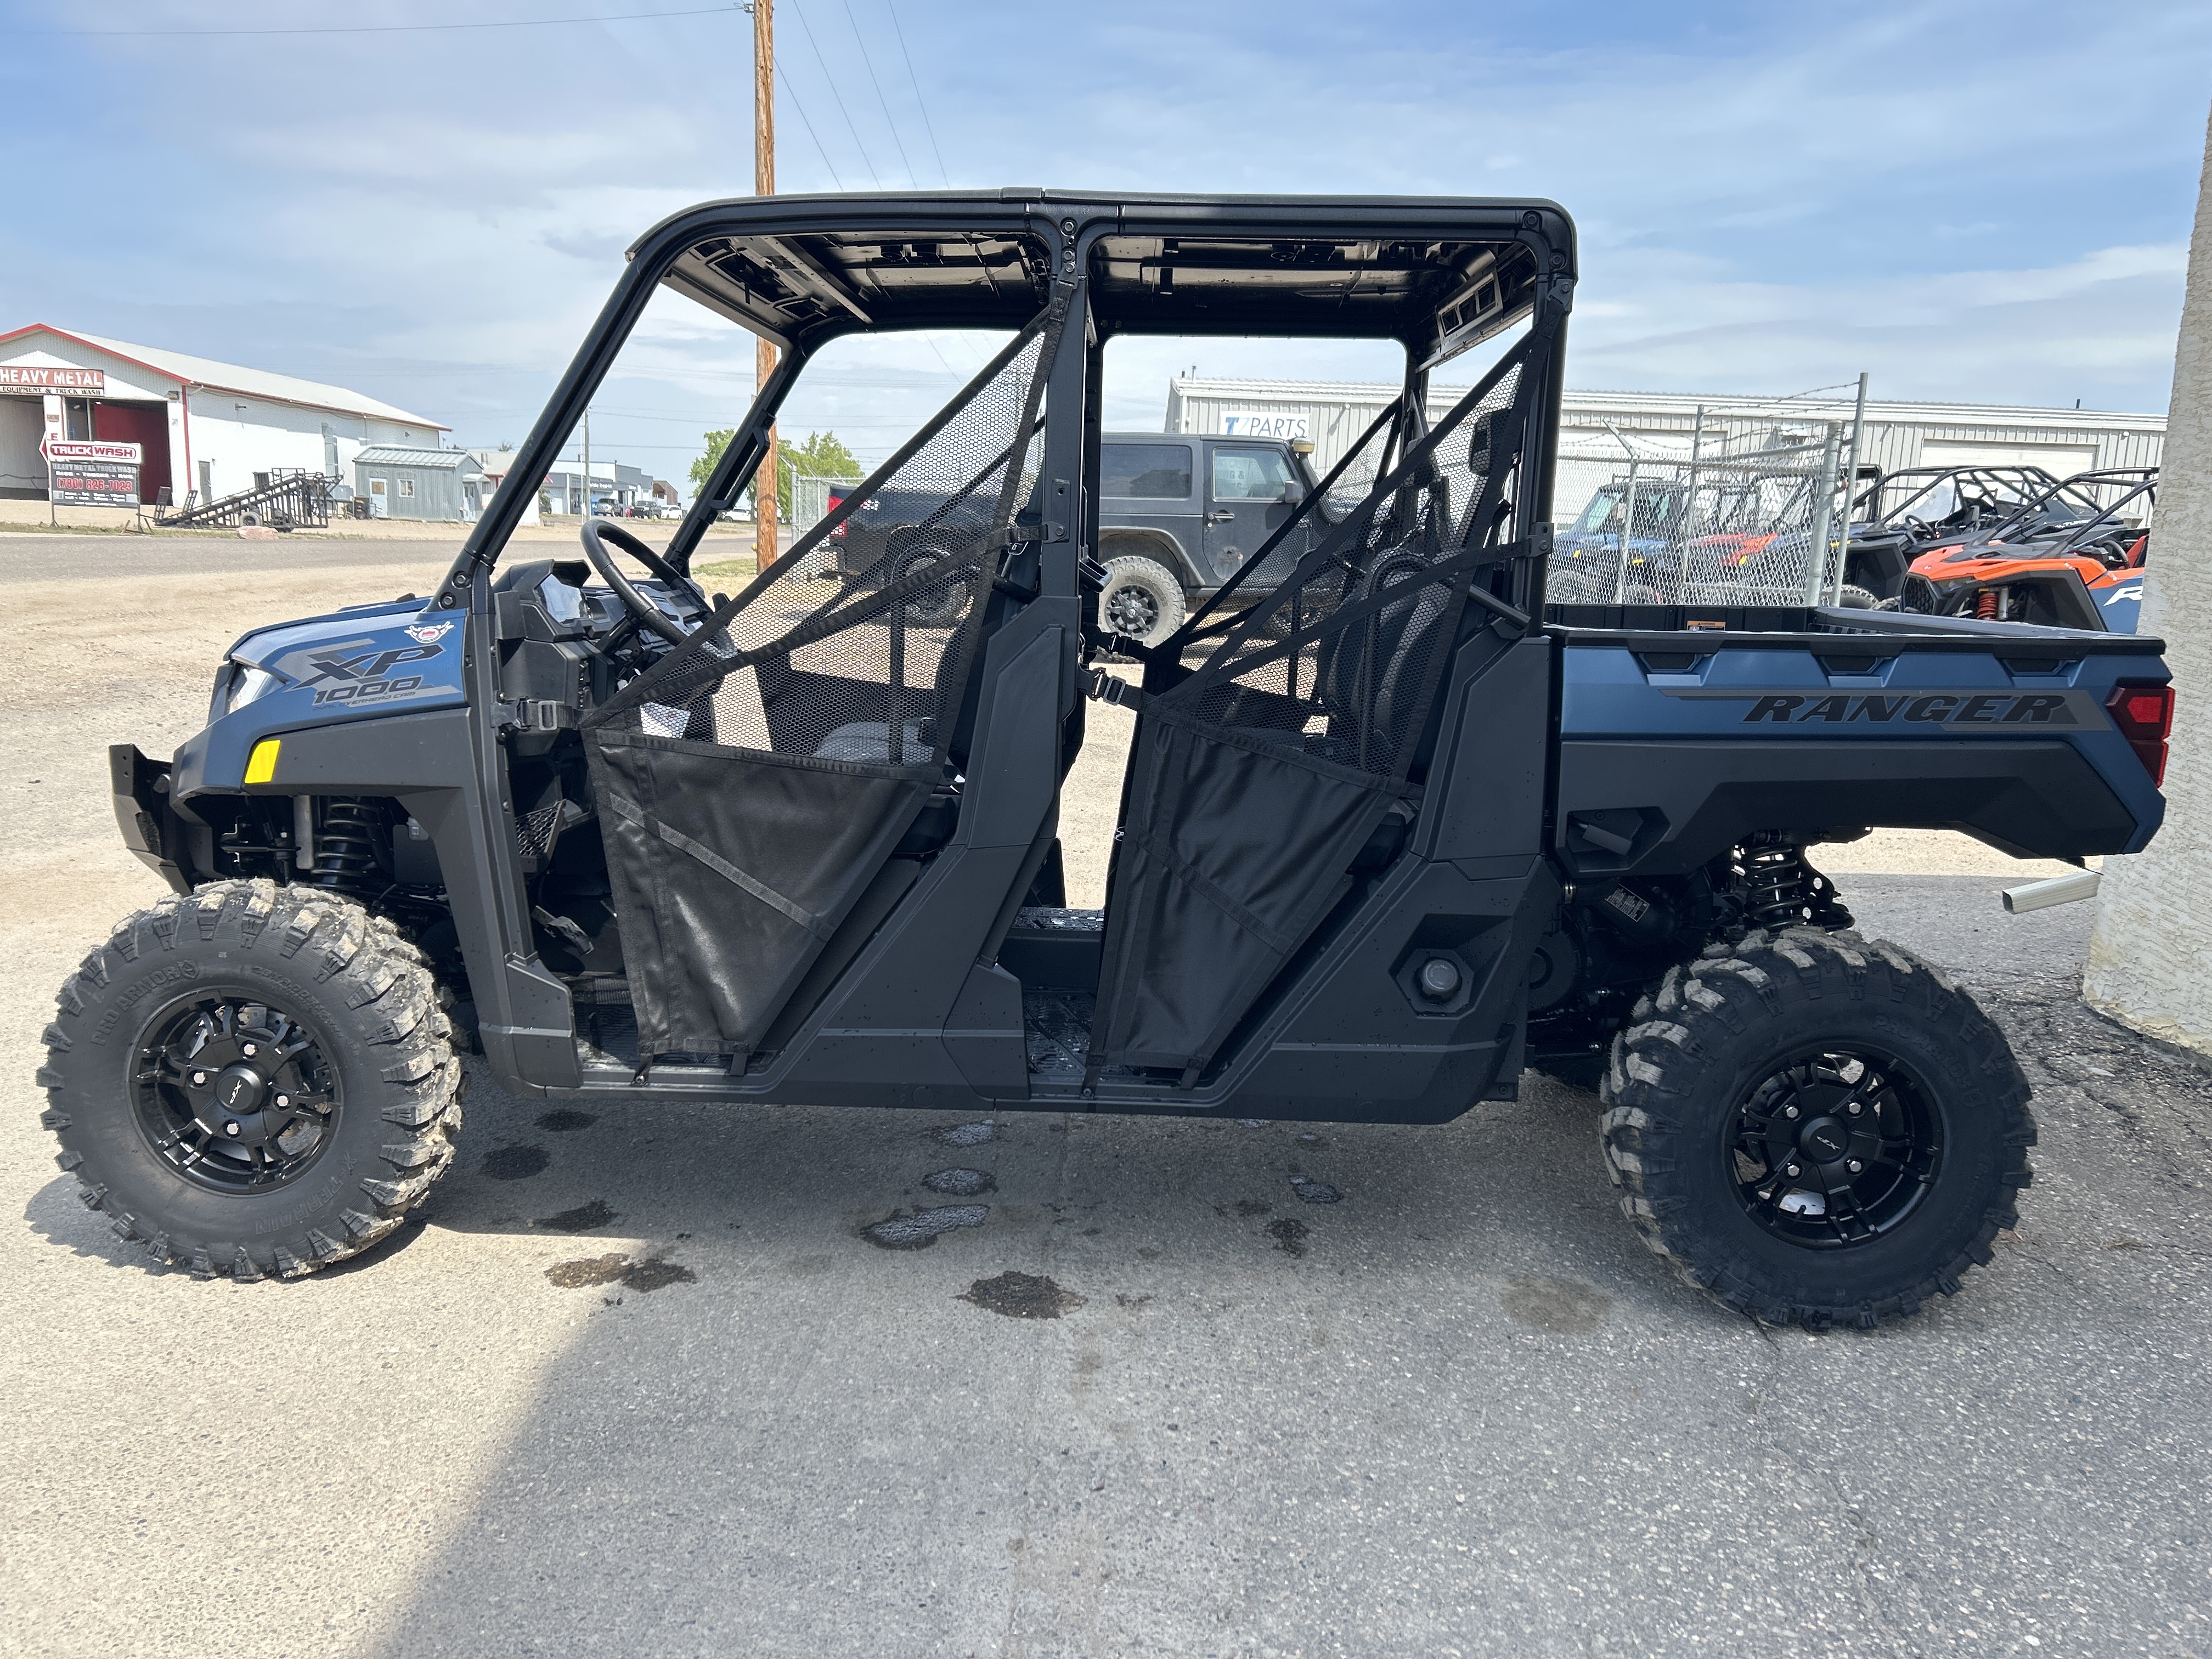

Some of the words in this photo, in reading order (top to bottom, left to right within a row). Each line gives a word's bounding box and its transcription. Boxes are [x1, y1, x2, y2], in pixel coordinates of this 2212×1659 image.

[0, 369, 48, 384] HEAVY
[54, 370, 103, 386] METAL
[1250, 417, 1307, 438] PARTS
[51, 445, 92, 455] TRUCK
[94, 447, 133, 457] WASH
[57, 477, 83, 489] (780)
[86, 478, 132, 492] 826-7023
[290, 644, 445, 690] XP
[314, 676, 422, 704] 1000
[339, 695, 391, 707] OVERHEAD
[1741, 695, 2066, 723] RANGER
[90, 1009, 120, 1047] PRO
[115, 966, 181, 1012] ARMOR
[256, 1151, 358, 1235] X-TERRAIN
